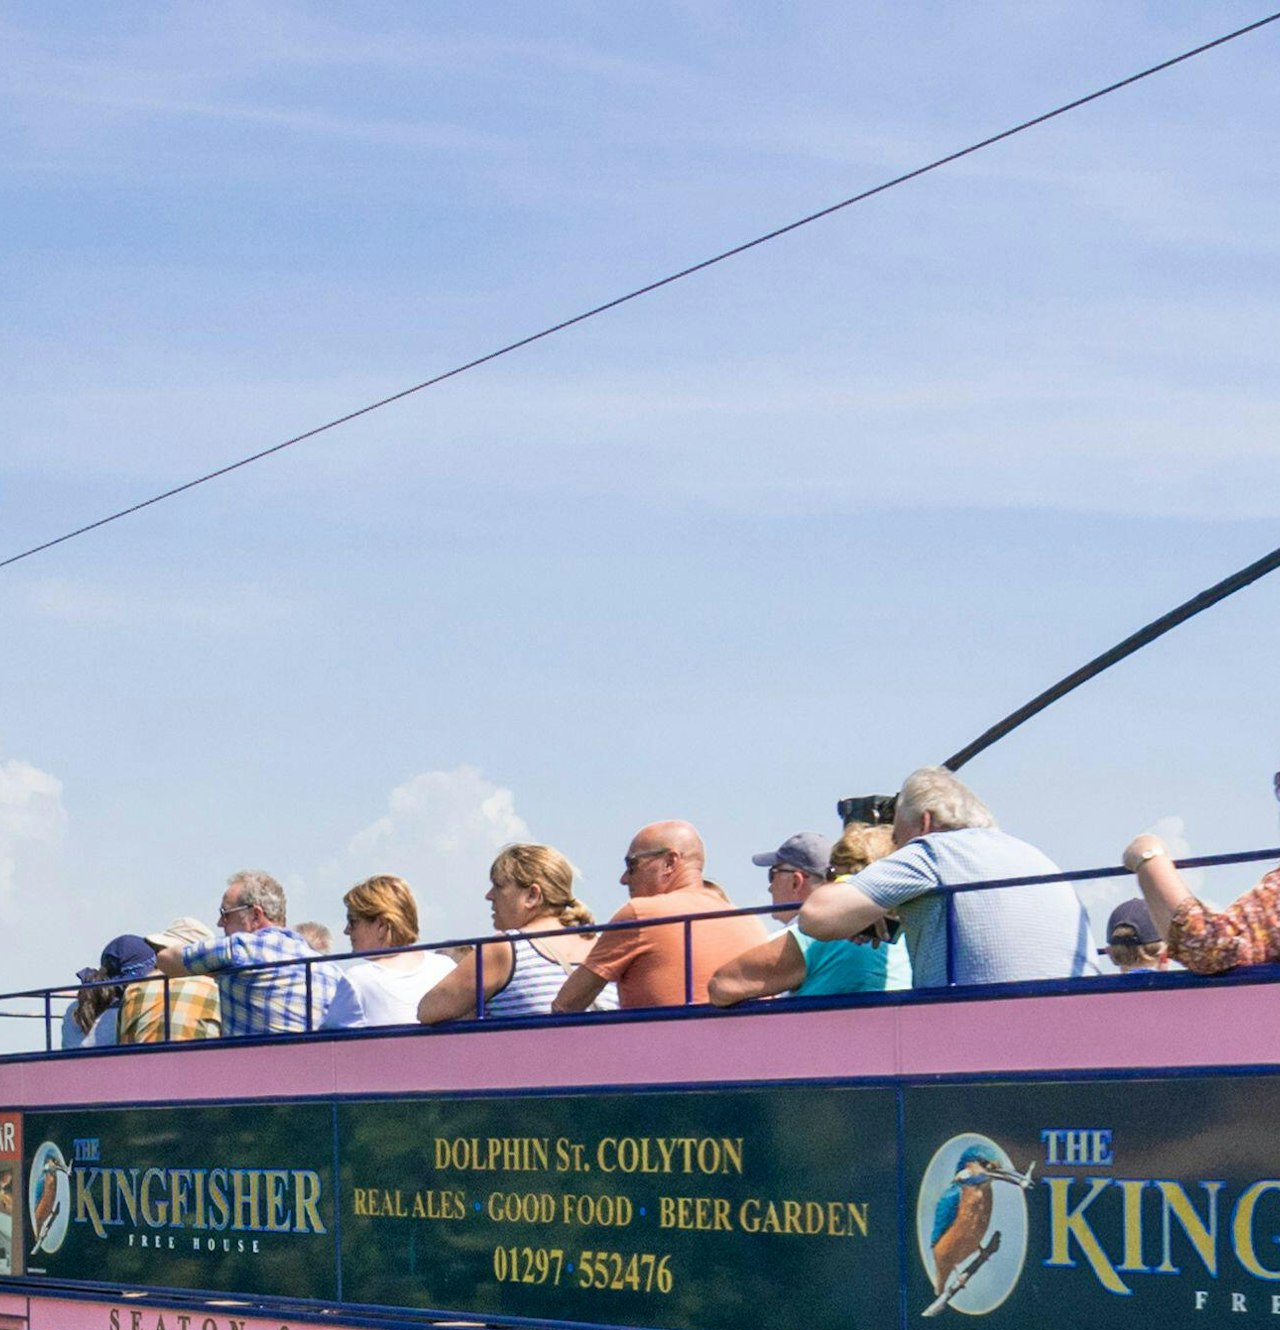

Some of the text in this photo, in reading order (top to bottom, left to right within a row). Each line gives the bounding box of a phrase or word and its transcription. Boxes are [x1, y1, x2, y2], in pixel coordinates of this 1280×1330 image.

[73, 1138, 101, 1161] THE
[434, 1137, 549, 1171] DOLPHIN
[596, 1137, 744, 1174] COLYTON
[1040, 1128, 1114, 1166] THE
[73, 1167, 328, 1239] KINGFISHER
[353, 1188, 869, 1237] REAL ALES GOOD FOOD BEER GARDEN
[128, 1234, 260, 1253] FREE HOUSE
[493, 1246, 674, 1294] 01297 552476
